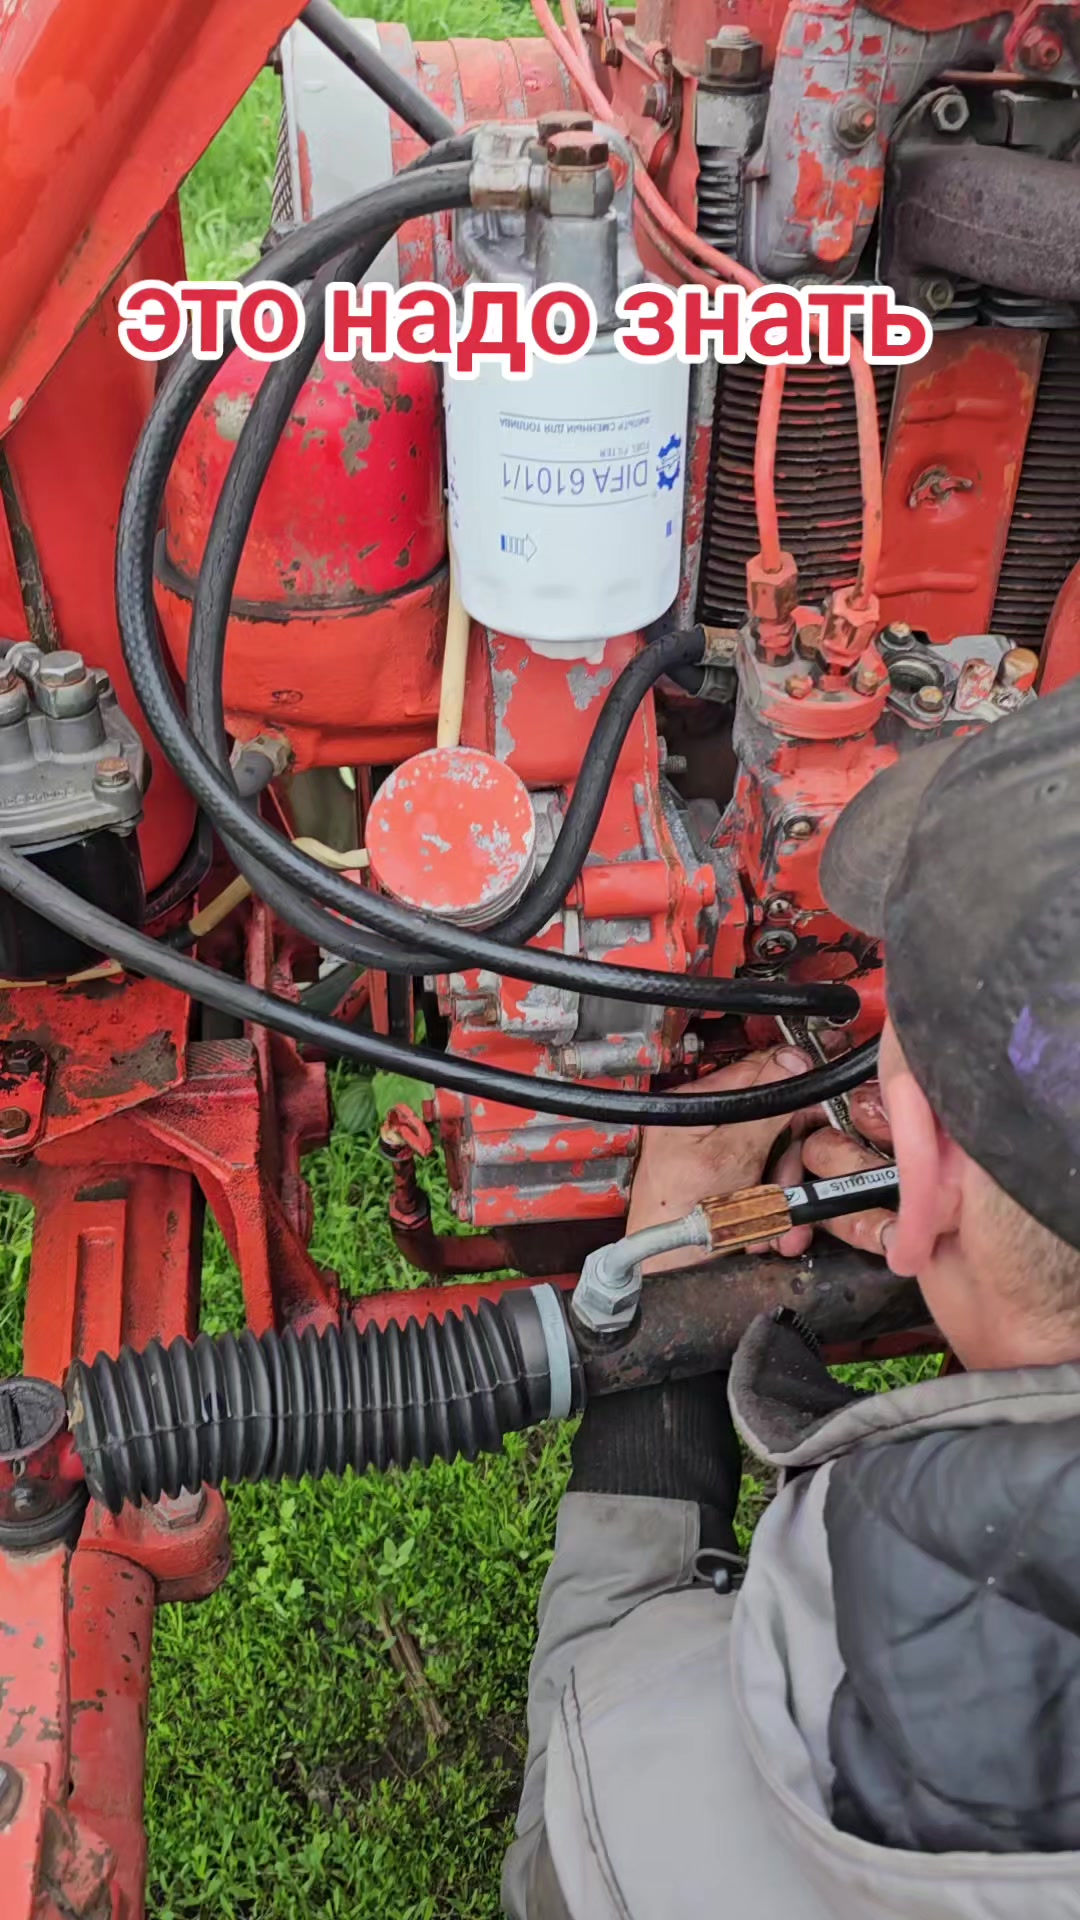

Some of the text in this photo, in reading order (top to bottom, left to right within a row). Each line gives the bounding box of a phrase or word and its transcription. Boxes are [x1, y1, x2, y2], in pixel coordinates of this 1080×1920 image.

[500, 417, 542, 433] ТОПЛИВА
[543, 422, 565, 434] ДЛЯ
[503, 459, 648, 495] DIFA 6101/1
[829, 1169, 898, 1193] oimpuls
